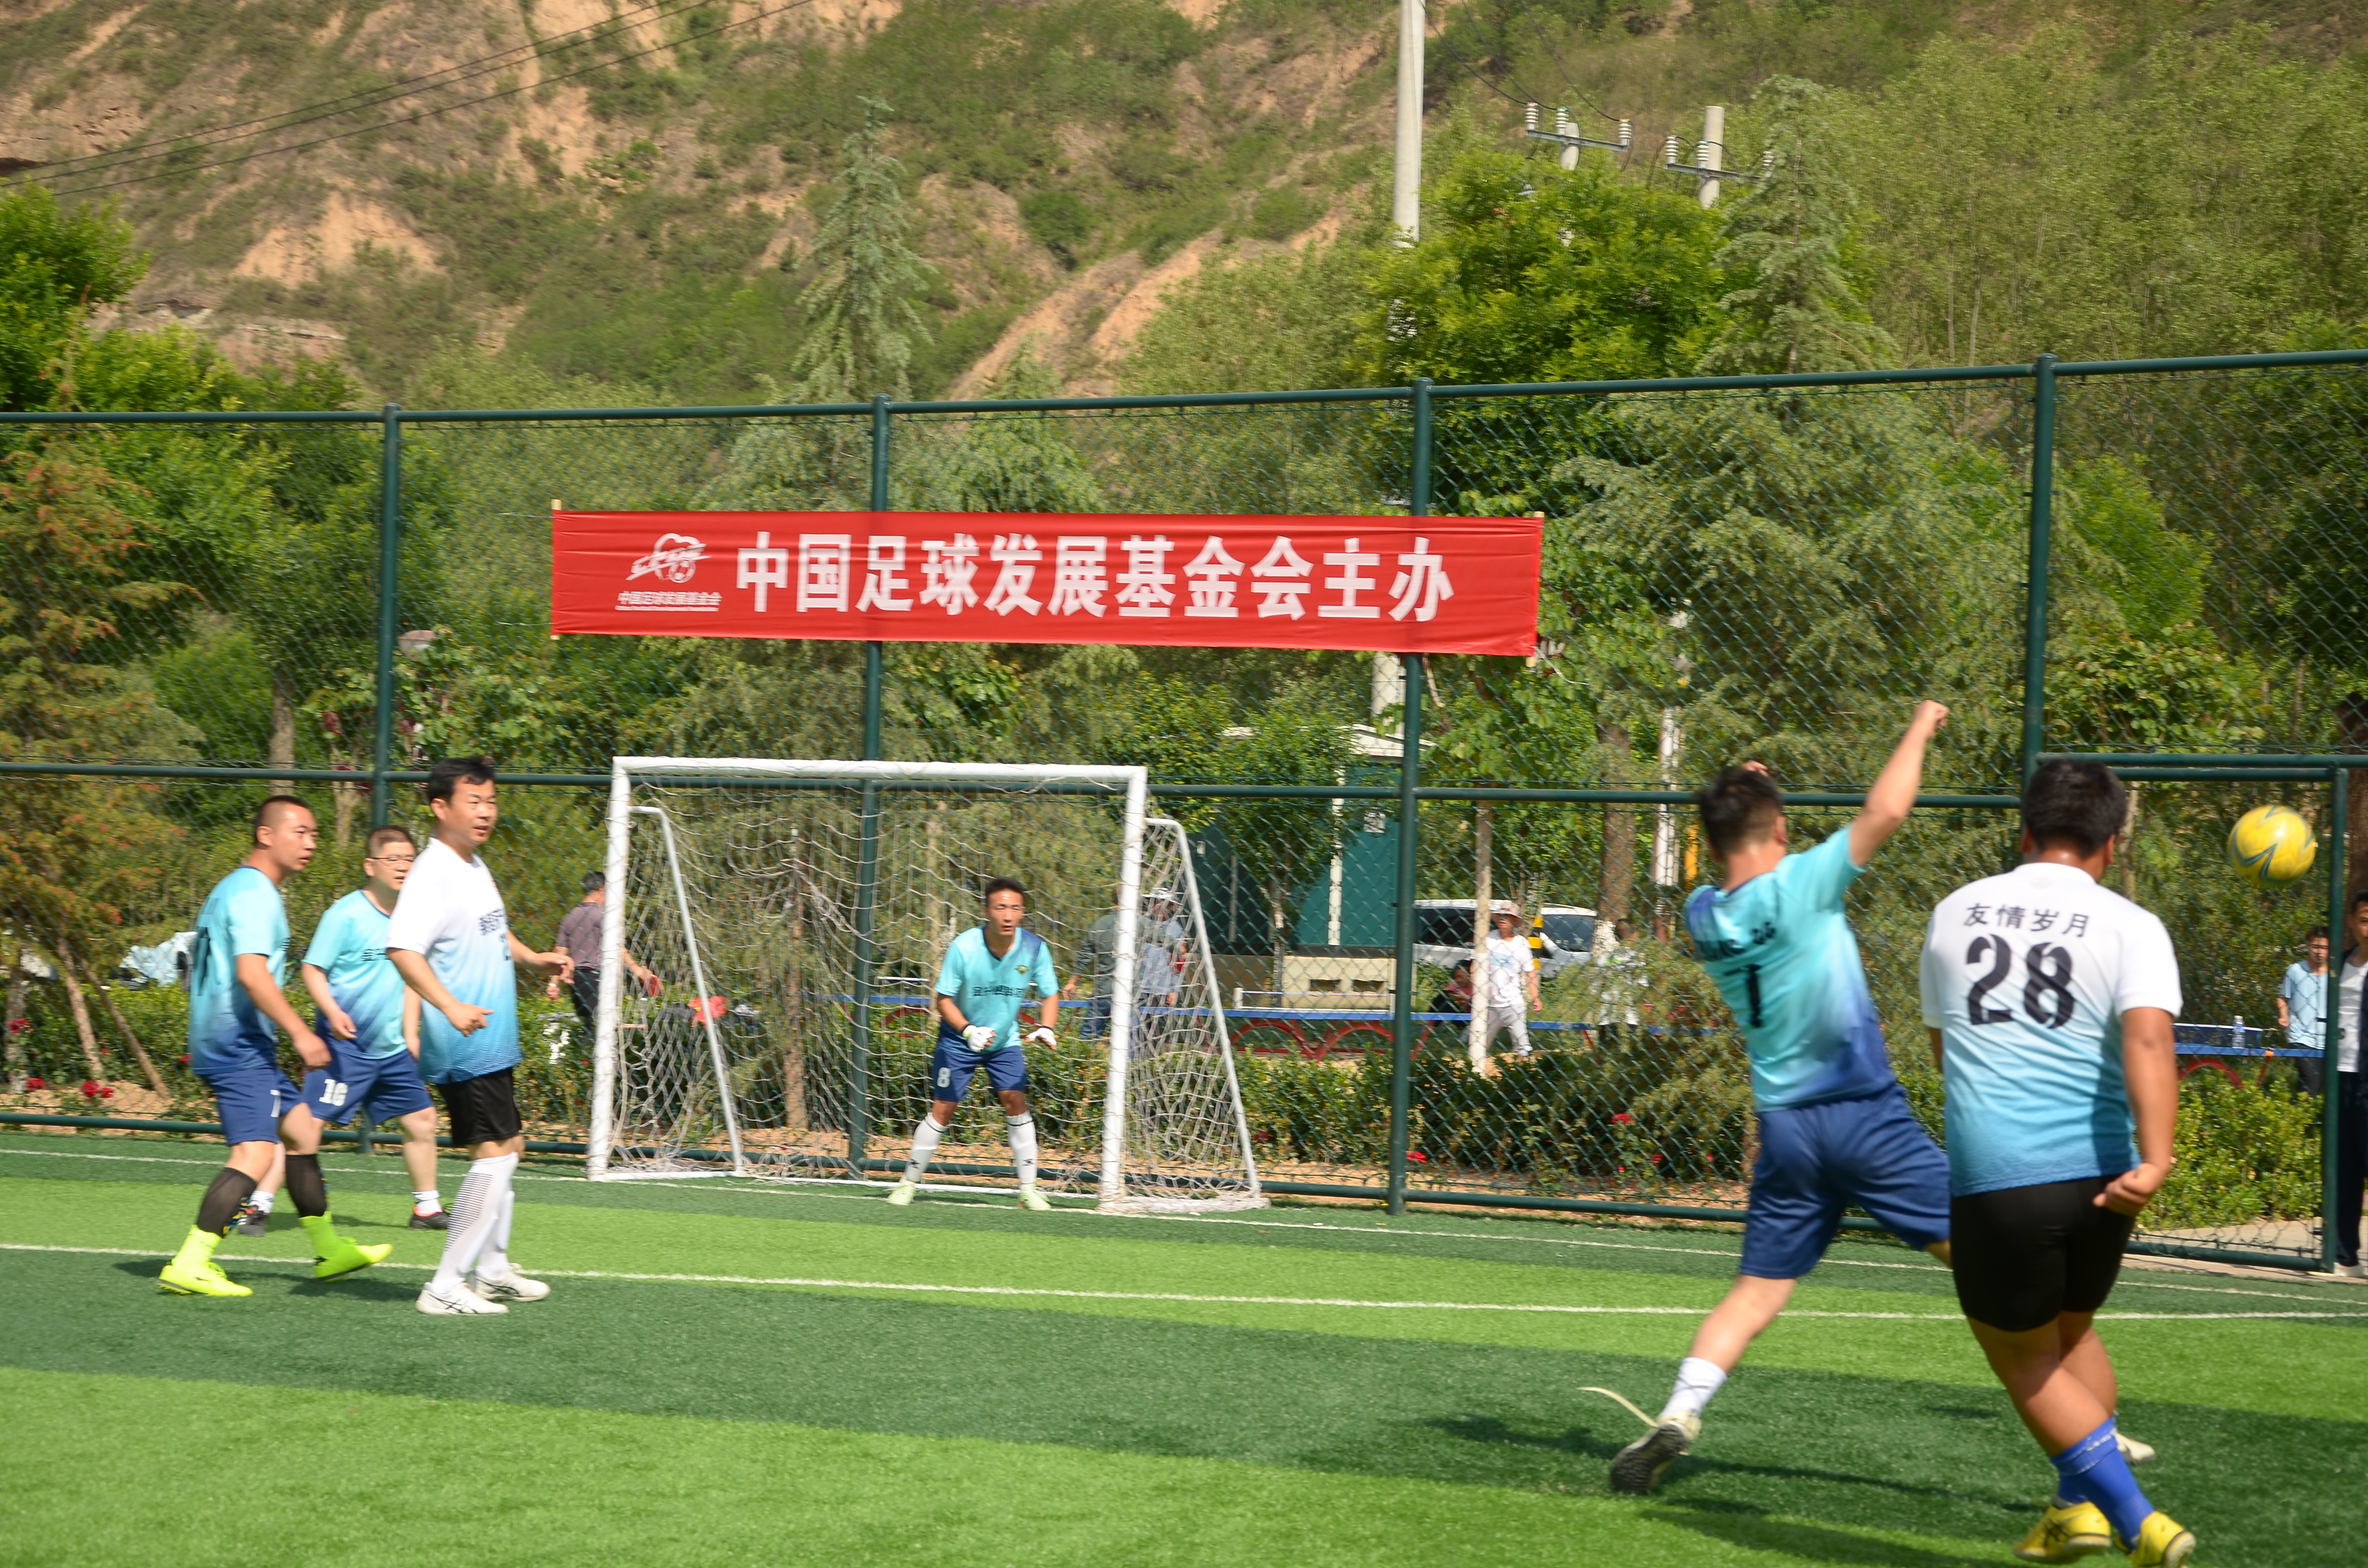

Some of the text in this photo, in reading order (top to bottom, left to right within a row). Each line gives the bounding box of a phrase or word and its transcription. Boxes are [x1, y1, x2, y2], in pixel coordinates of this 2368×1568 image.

[736, 531, 1455, 621] 中国足球发展基金会主办
[1963, 903, 2089, 937] 友情岁月
[1966, 933, 2075, 1029] 28
[937, 1067, 951, 1088] 8
